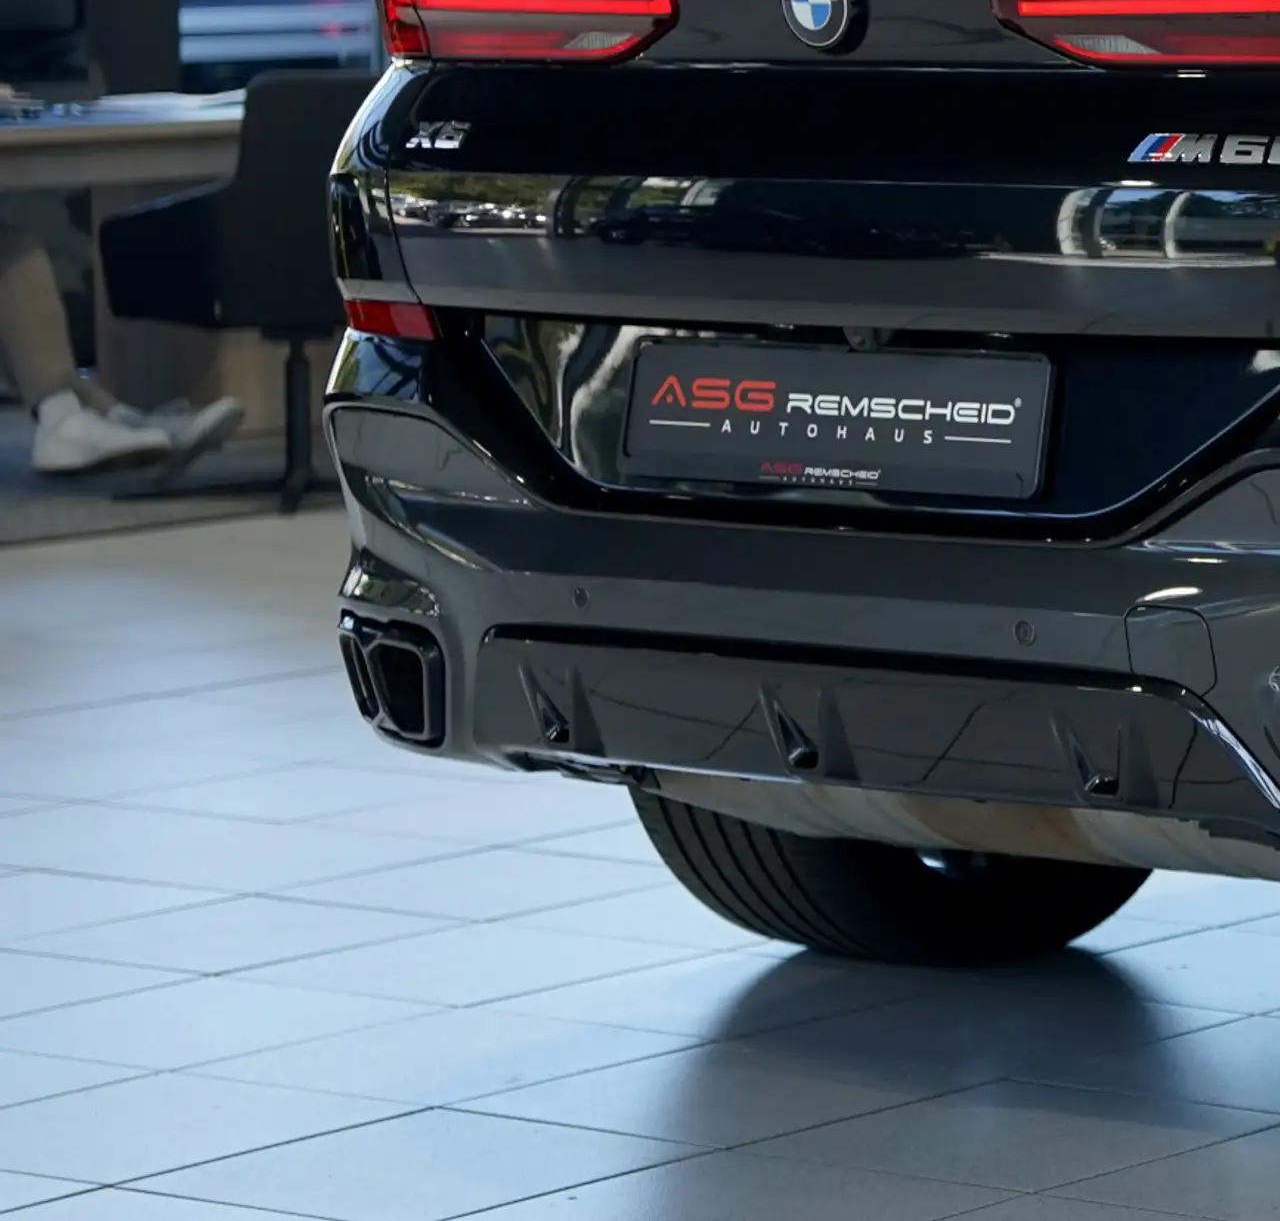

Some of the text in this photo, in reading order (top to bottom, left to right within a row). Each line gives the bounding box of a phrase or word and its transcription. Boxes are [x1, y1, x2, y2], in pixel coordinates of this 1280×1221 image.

[405, 120, 471, 149] X6
[651, 376, 776, 412] ASG
[721, 418, 934, 445] AUTOHAUS
